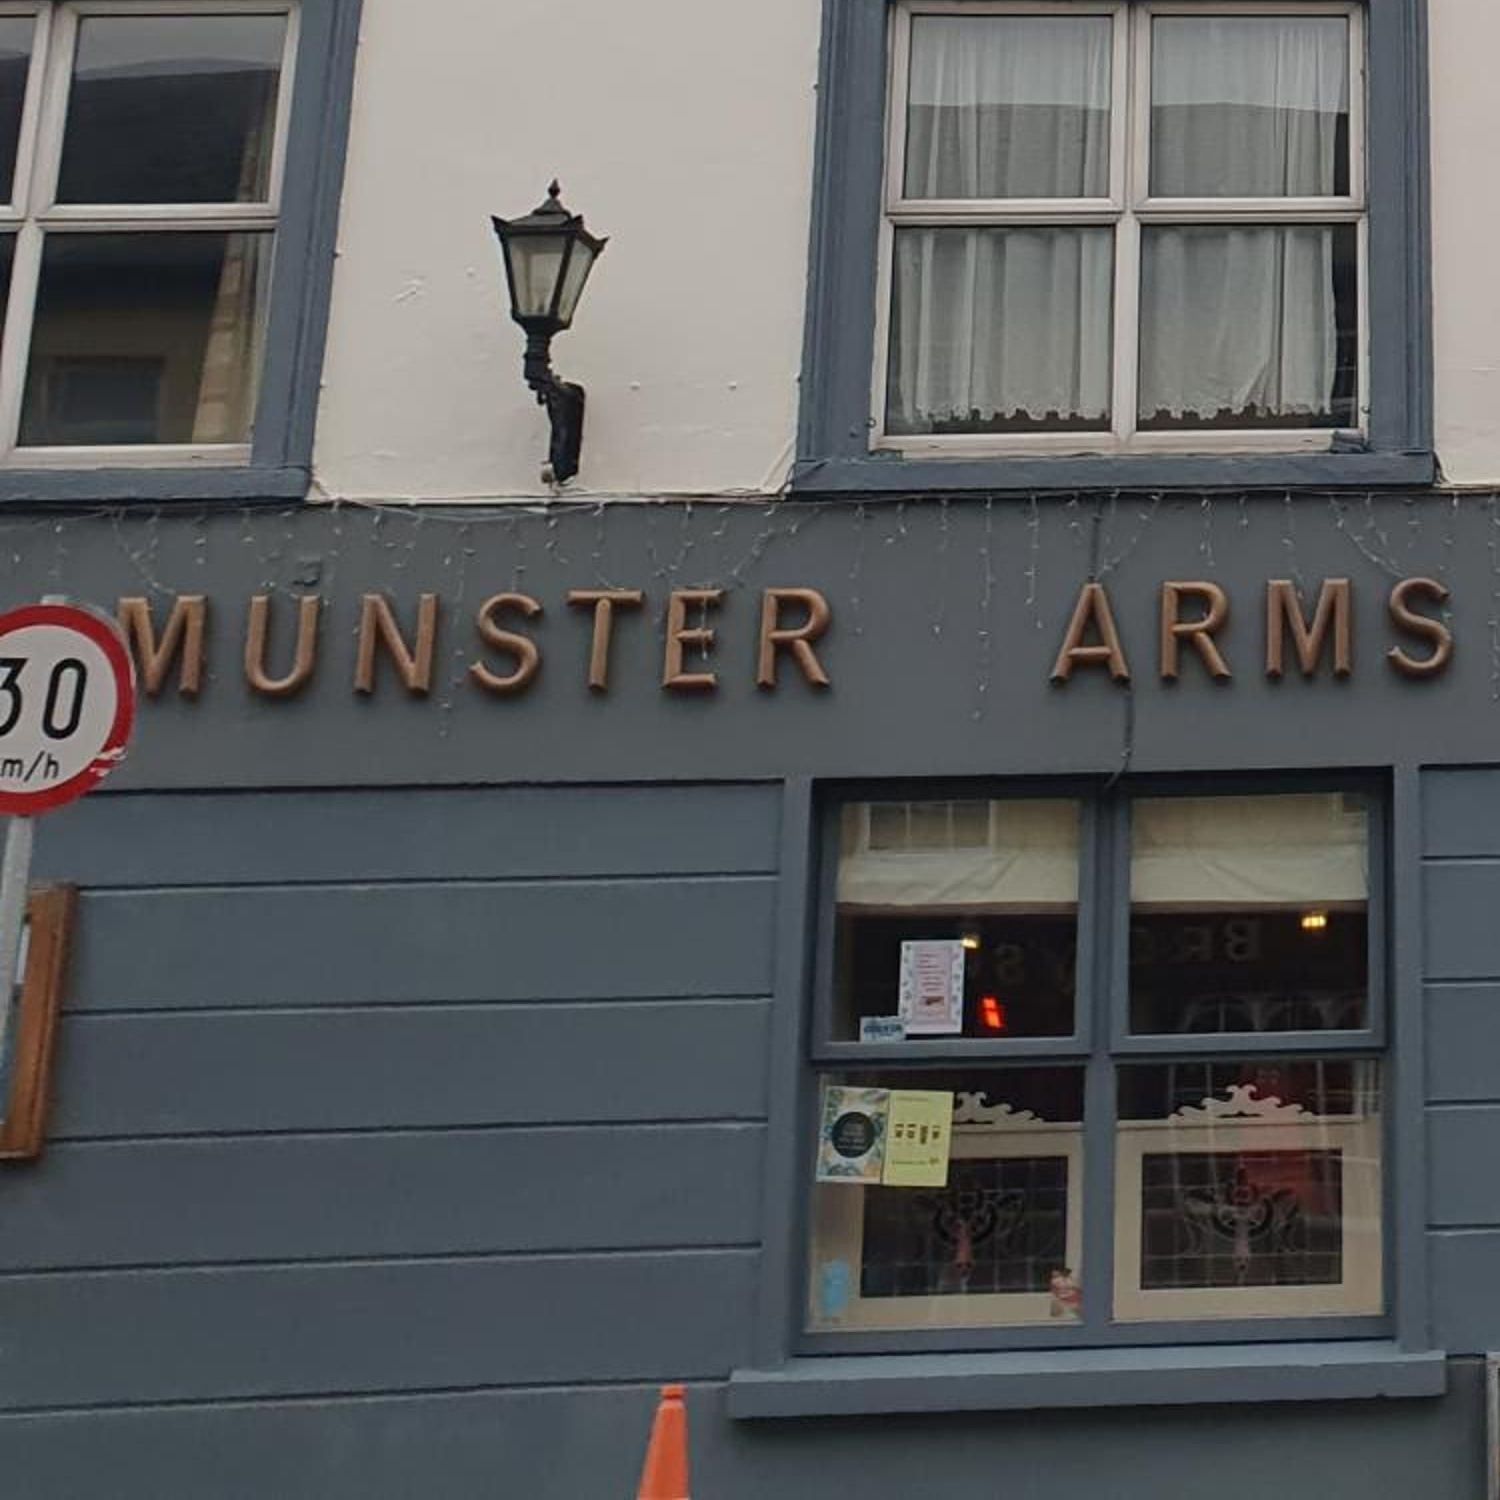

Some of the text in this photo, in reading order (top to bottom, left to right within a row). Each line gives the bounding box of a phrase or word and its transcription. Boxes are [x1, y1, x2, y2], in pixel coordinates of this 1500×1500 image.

[117, 586, 832, 697] MUNSTER
[1048, 577, 1453, 682] ARMS
[0, 657, 88, 740] 30
[0, 750, 60, 783] m/h
